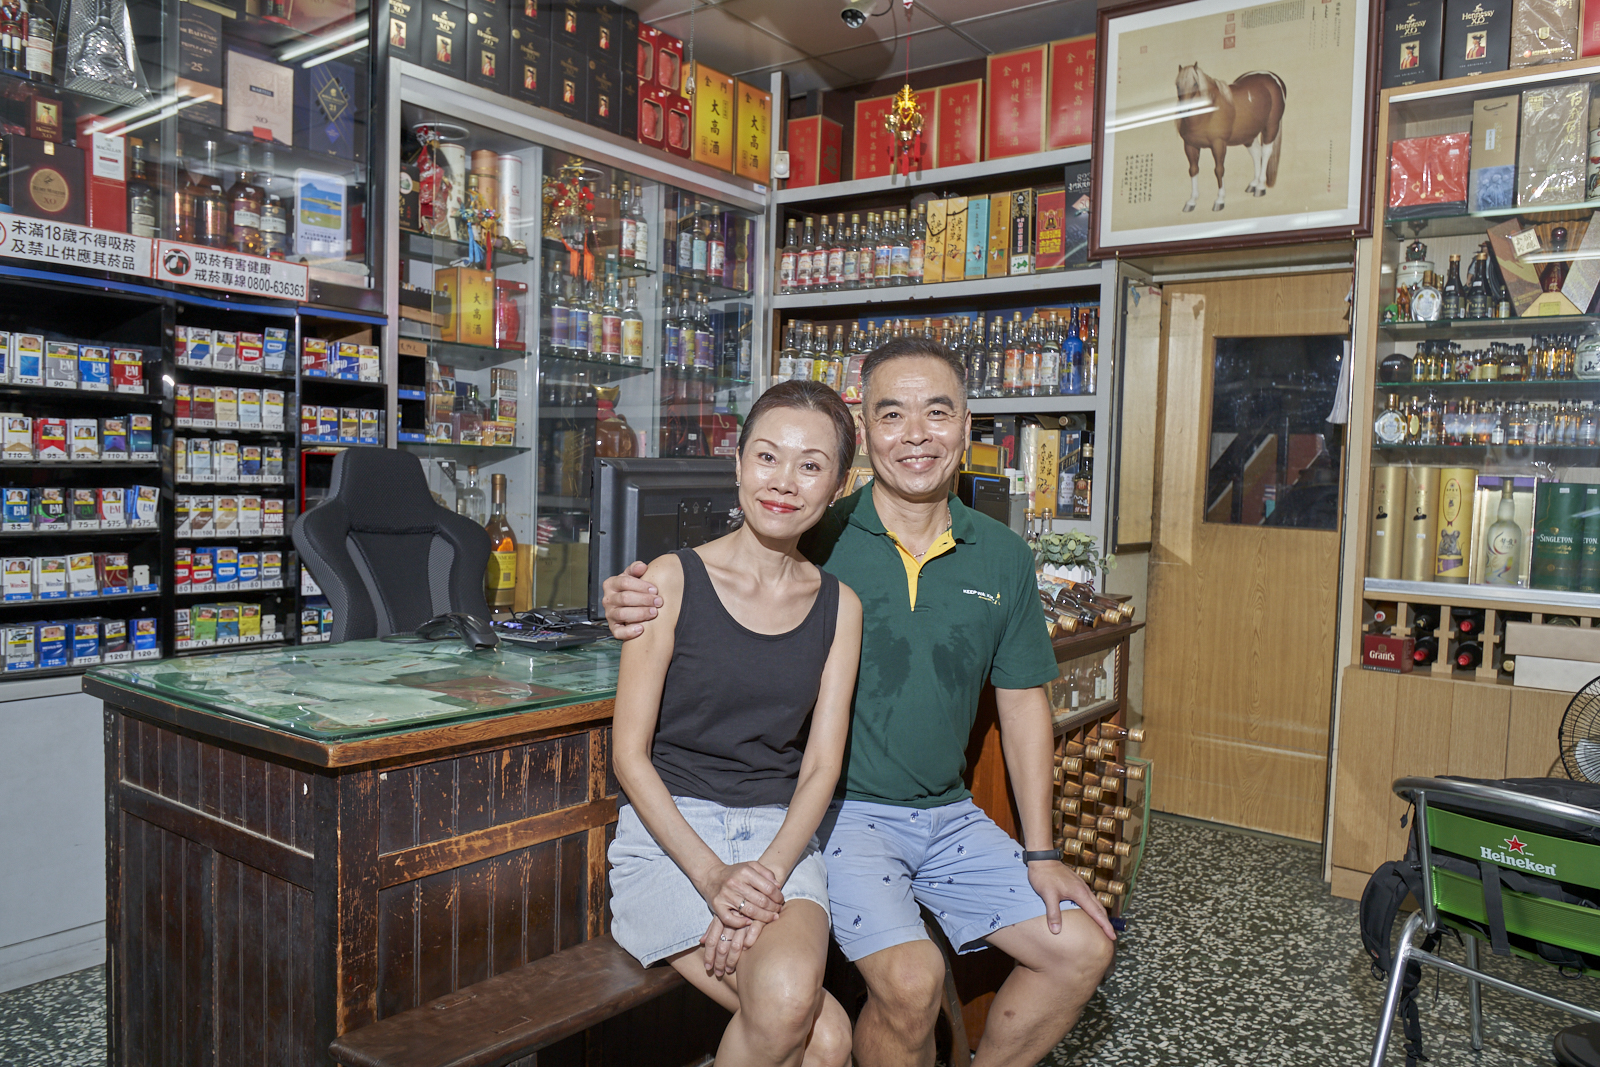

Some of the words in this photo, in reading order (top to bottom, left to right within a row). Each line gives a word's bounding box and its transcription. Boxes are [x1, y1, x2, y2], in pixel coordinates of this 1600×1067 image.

[1462, 10, 1495, 21] Hennessy
[1395, 20, 1426, 31] Hennessy
[191, 61, 203, 72] 25
[256, 115, 268, 124] XO
[43, 197, 57, 205] XO
[12, 220, 136, 253] 未滿18歲不得吸菸
[11, 238, 135, 271] 及禁止供應其菸品
[195, 251, 271, 275] 吸菸有害健康
[265, 513, 283, 523] KANE
[1540, 533, 1574, 544] SINGLETON
[195, 639, 208, 647] 70
[1369, 649, 1395, 662] Grant's
[1480, 846, 1556, 876] Heineken
